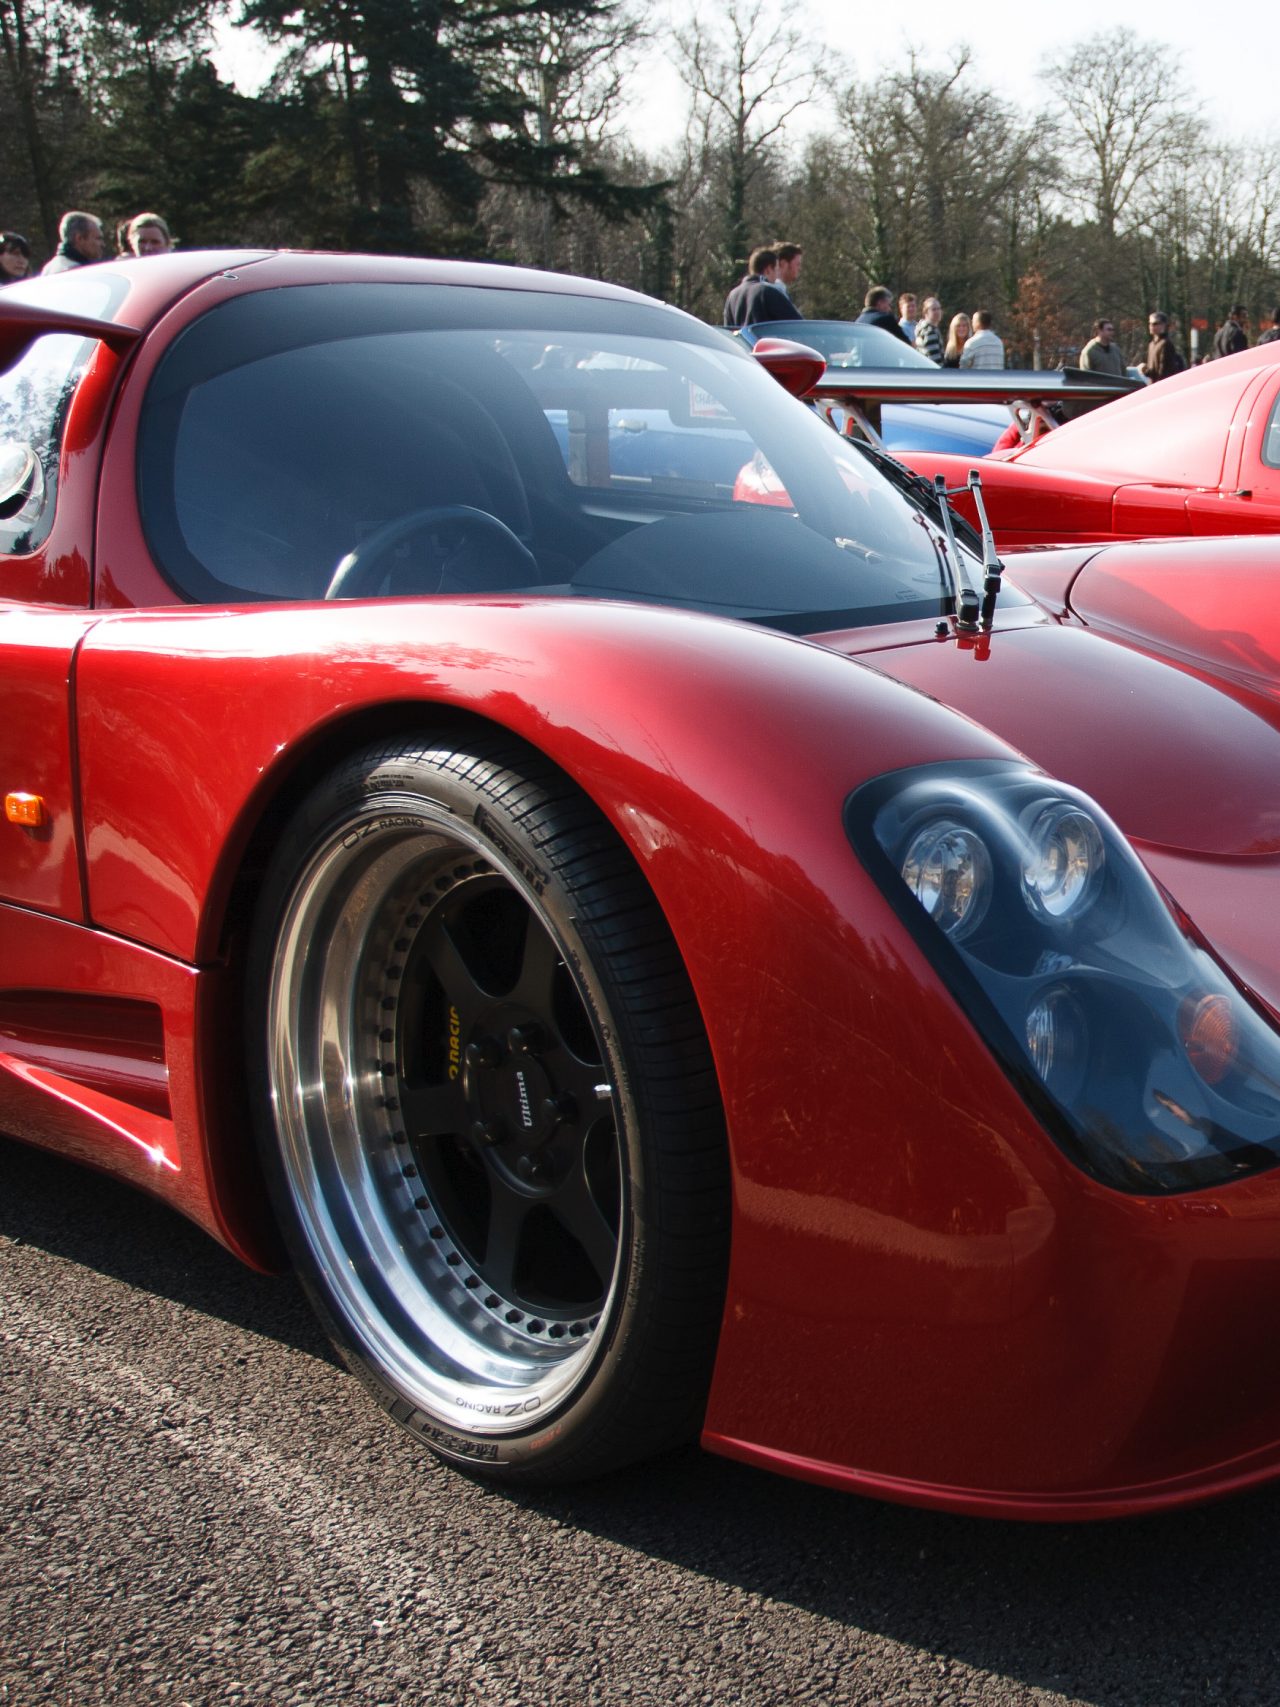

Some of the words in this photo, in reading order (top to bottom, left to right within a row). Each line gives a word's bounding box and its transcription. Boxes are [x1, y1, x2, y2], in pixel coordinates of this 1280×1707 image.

[379, 817, 424, 830] RACING
[516, 1071, 533, 1127] Ultima
[455, 1397, 501, 1414] RACING
[504, 1396, 541, 1417] OZ
